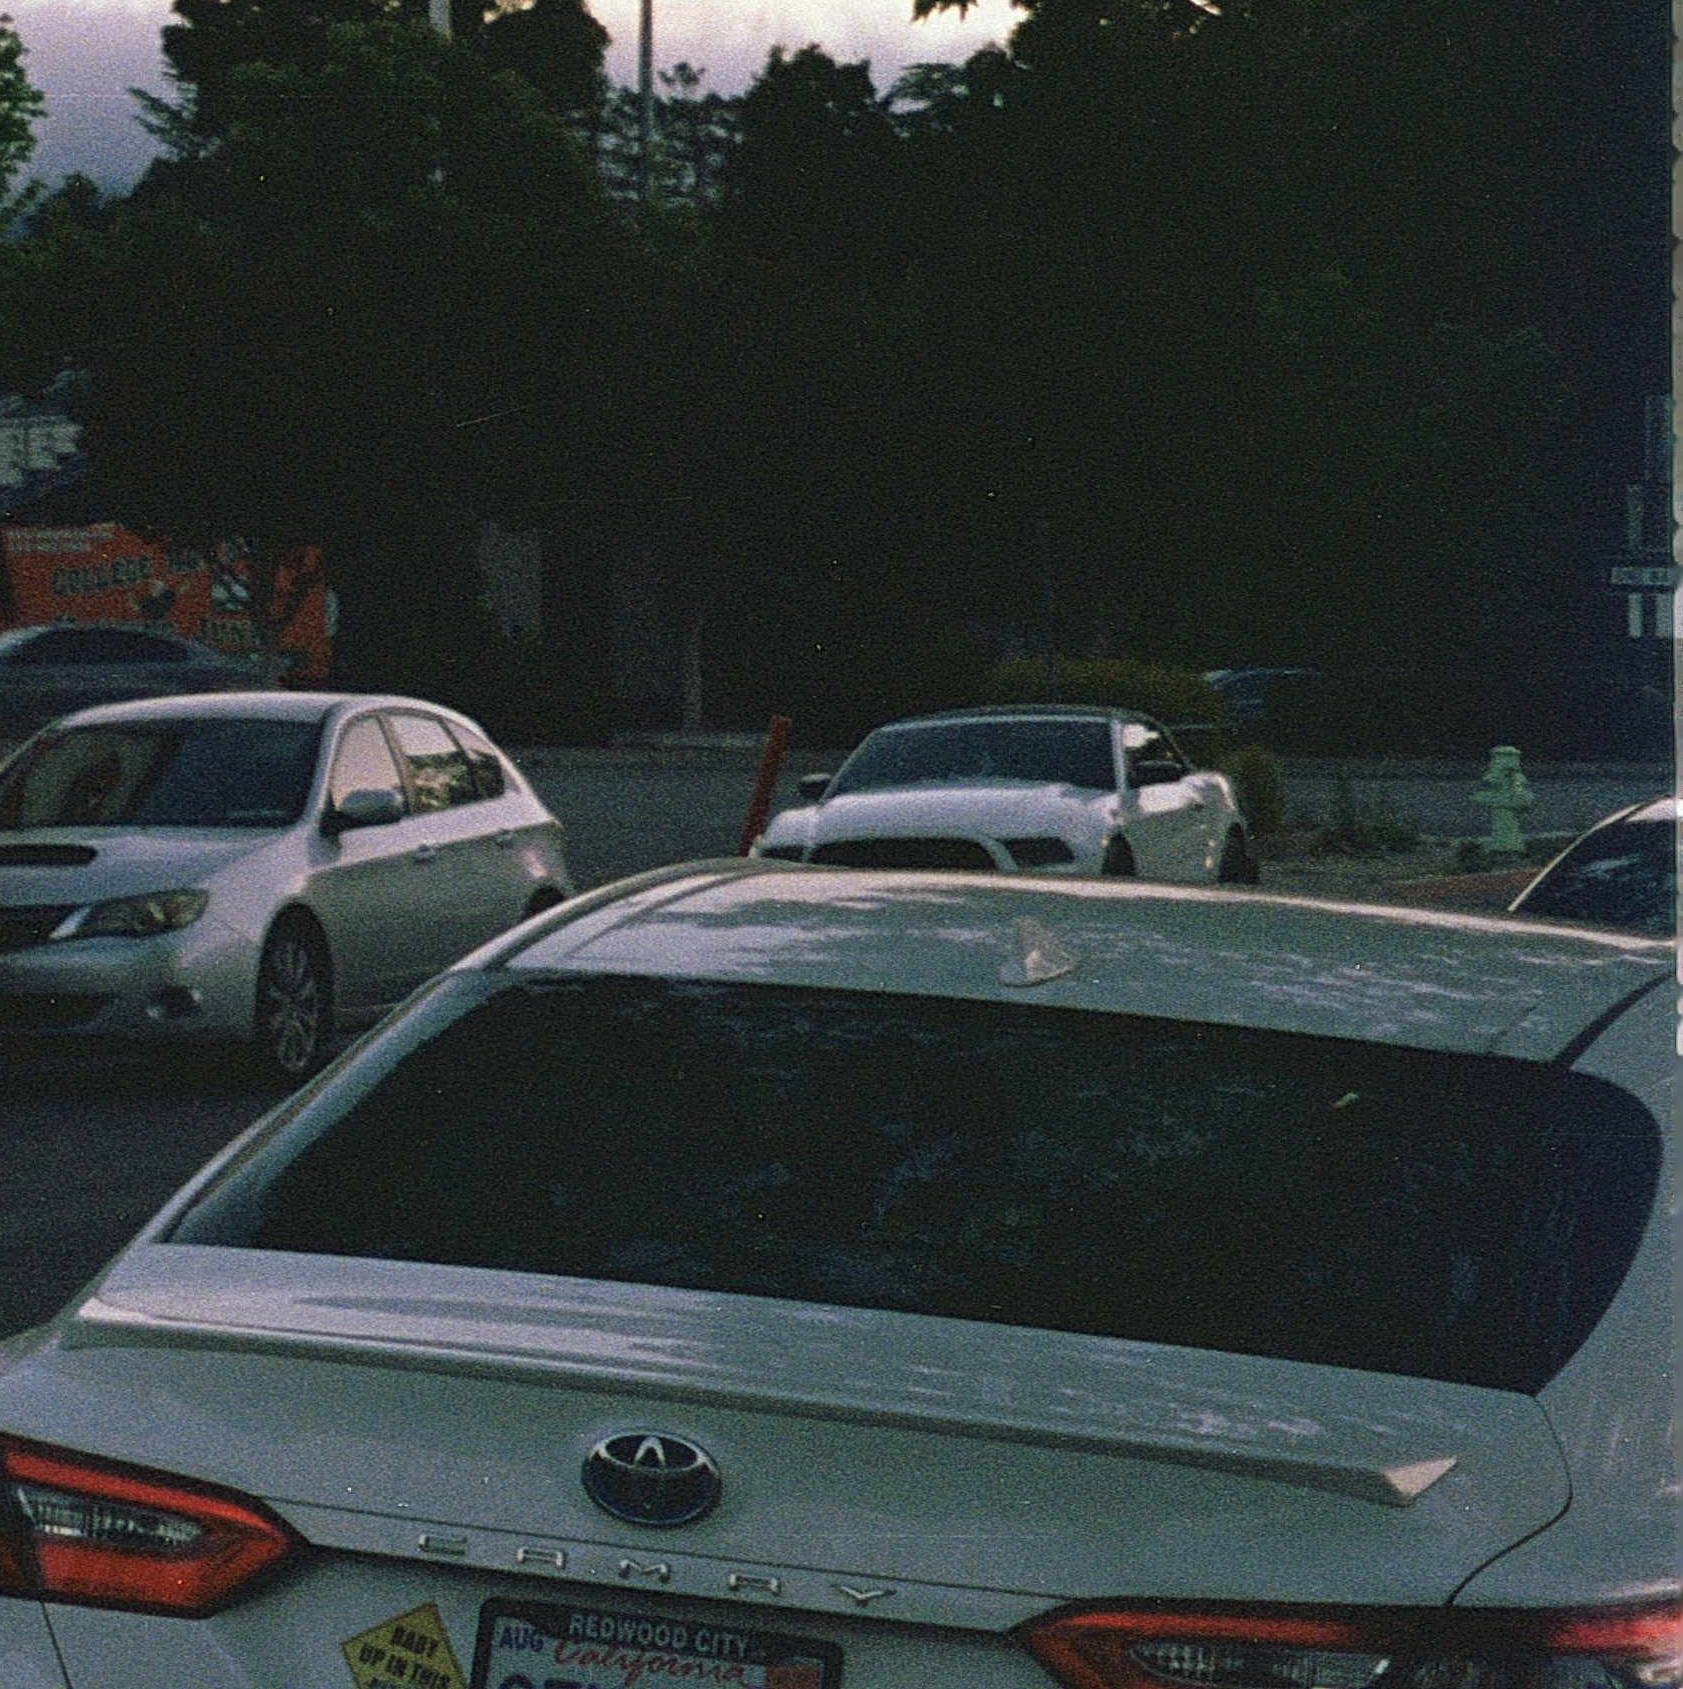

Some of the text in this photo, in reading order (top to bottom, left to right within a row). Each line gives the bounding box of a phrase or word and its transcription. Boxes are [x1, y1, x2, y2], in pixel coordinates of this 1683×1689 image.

[52, 554, 152, 596] COLLEGE
[417, 1532, 898, 1607] CAMRY
[390, 1624, 439, 1658] BABY
[499, 1625, 545, 1652] AUG
[568, 1612, 751, 1660] REDWOOD CITY
[359, 1642, 386, 1667] UP
[386, 1654, 408, 1678] IN
[410, 1661, 451, 1689] THIS
[554, 1639, 747, 1687] California
